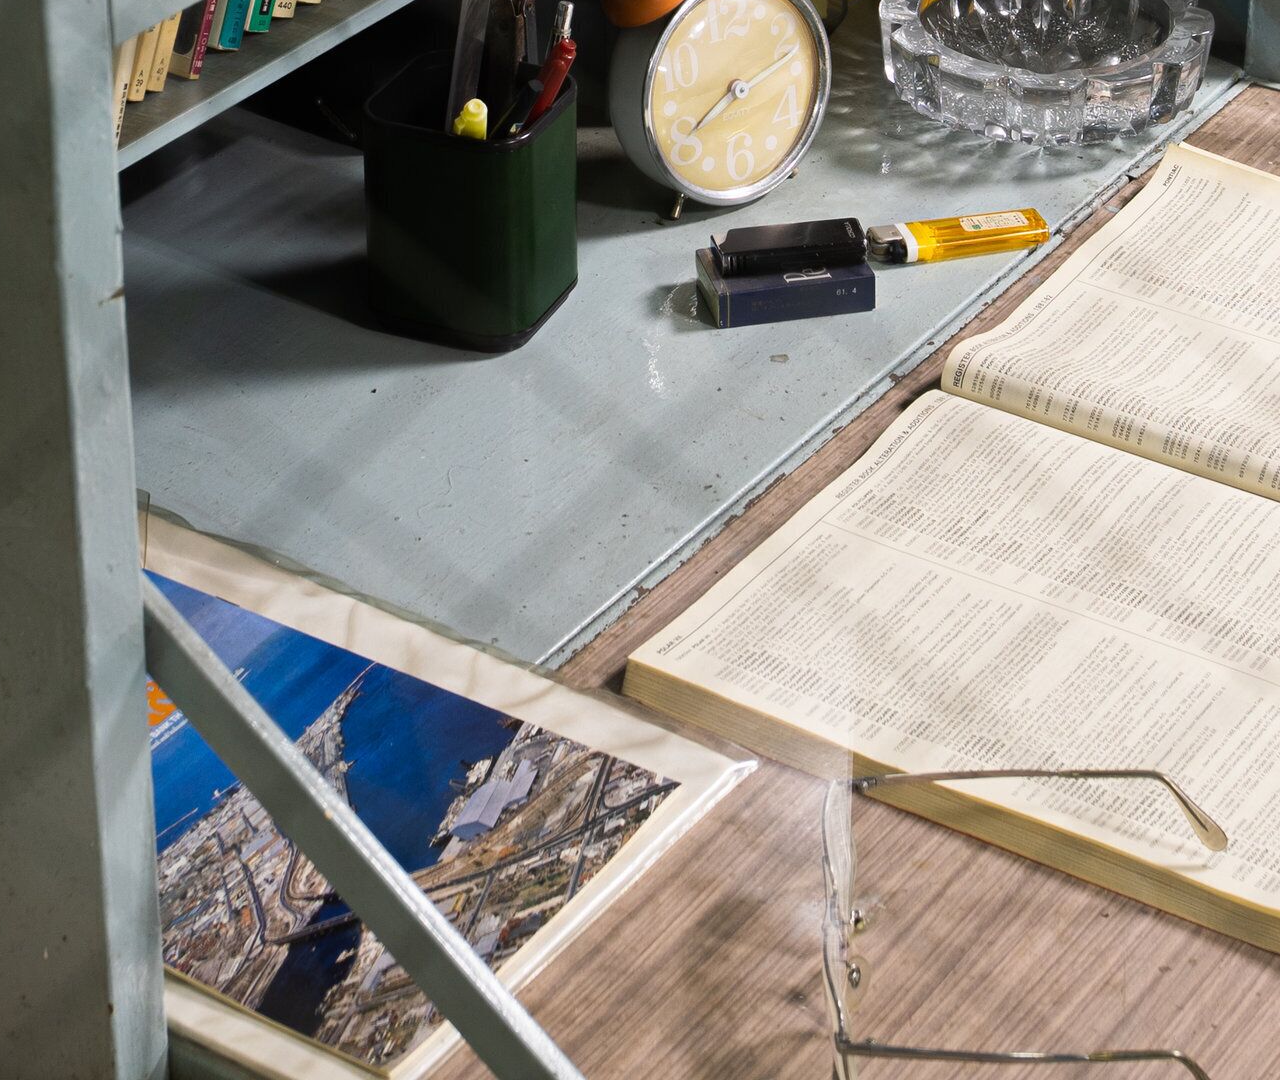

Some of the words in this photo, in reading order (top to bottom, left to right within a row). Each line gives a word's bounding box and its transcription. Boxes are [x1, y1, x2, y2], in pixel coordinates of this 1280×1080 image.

[277, 1, 293, 10] 440
[770, 11, 801, 61] 2
[658, 41, 700, 95] 10
[772, 85, 802, 130] 4
[670, 116, 703, 167] 8
[726, 132, 755, 182] 6
[1162, 164, 1179, 187] PONTIAC
[953, 351, 972, 388] REGISTER
[835, 477, 863, 500] REGISTER
[873, 434, 906, 467] ALTERATION
[907, 404, 936, 431] ADDITIONS
